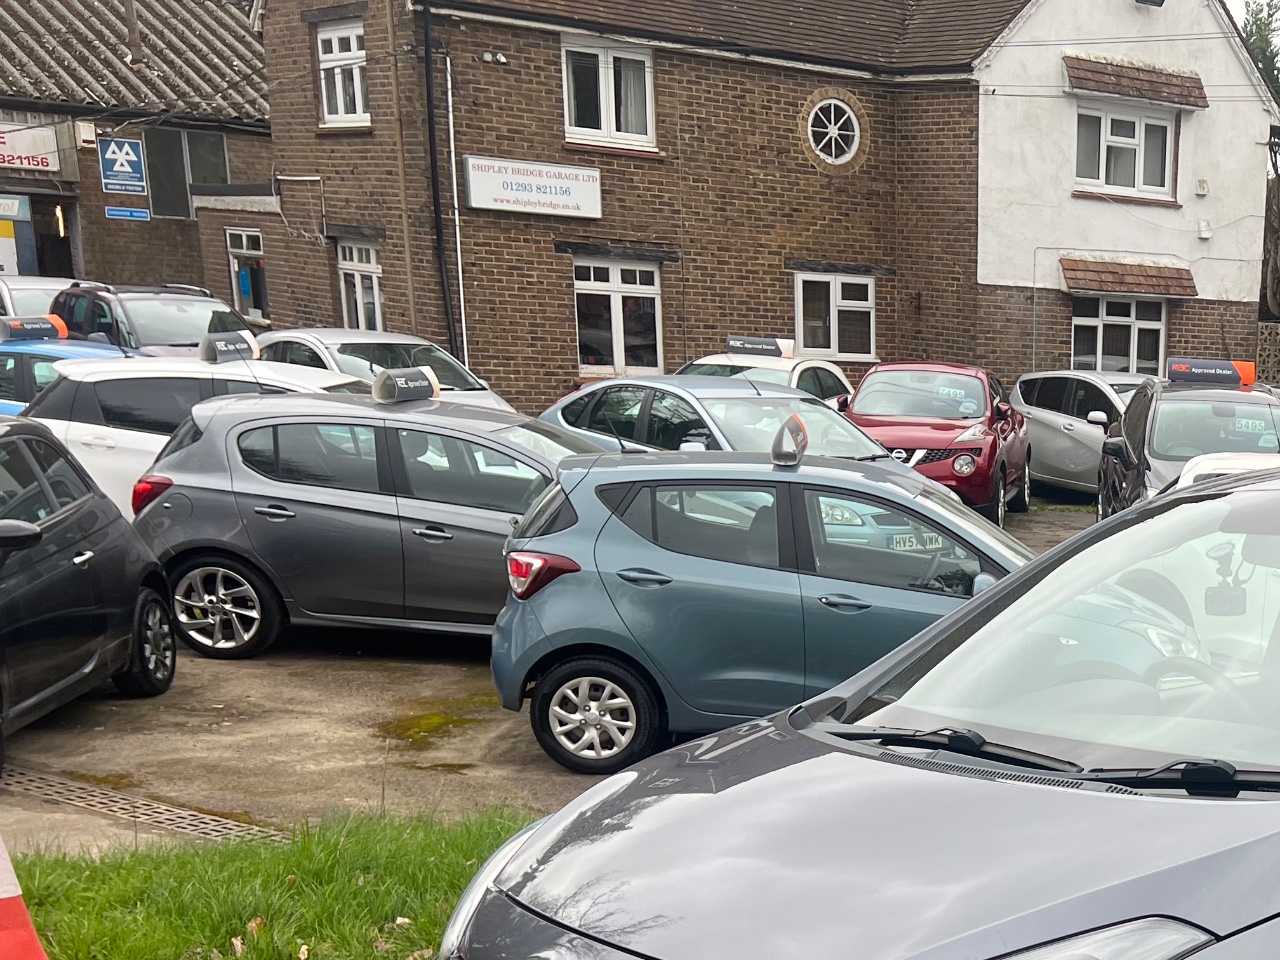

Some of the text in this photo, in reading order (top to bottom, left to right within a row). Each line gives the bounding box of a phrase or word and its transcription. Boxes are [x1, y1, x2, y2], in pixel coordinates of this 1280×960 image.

[471, 163, 598, 183] SHIPLEY BRIDGE GARAGE LTD
[502, 180, 571, 196] 01293 821156
[492, 196, 581, 211] www.shipleybridge.co.uk
[1236, 420, 1264, 432] 5495
[895, 536, 918, 549] HV5
